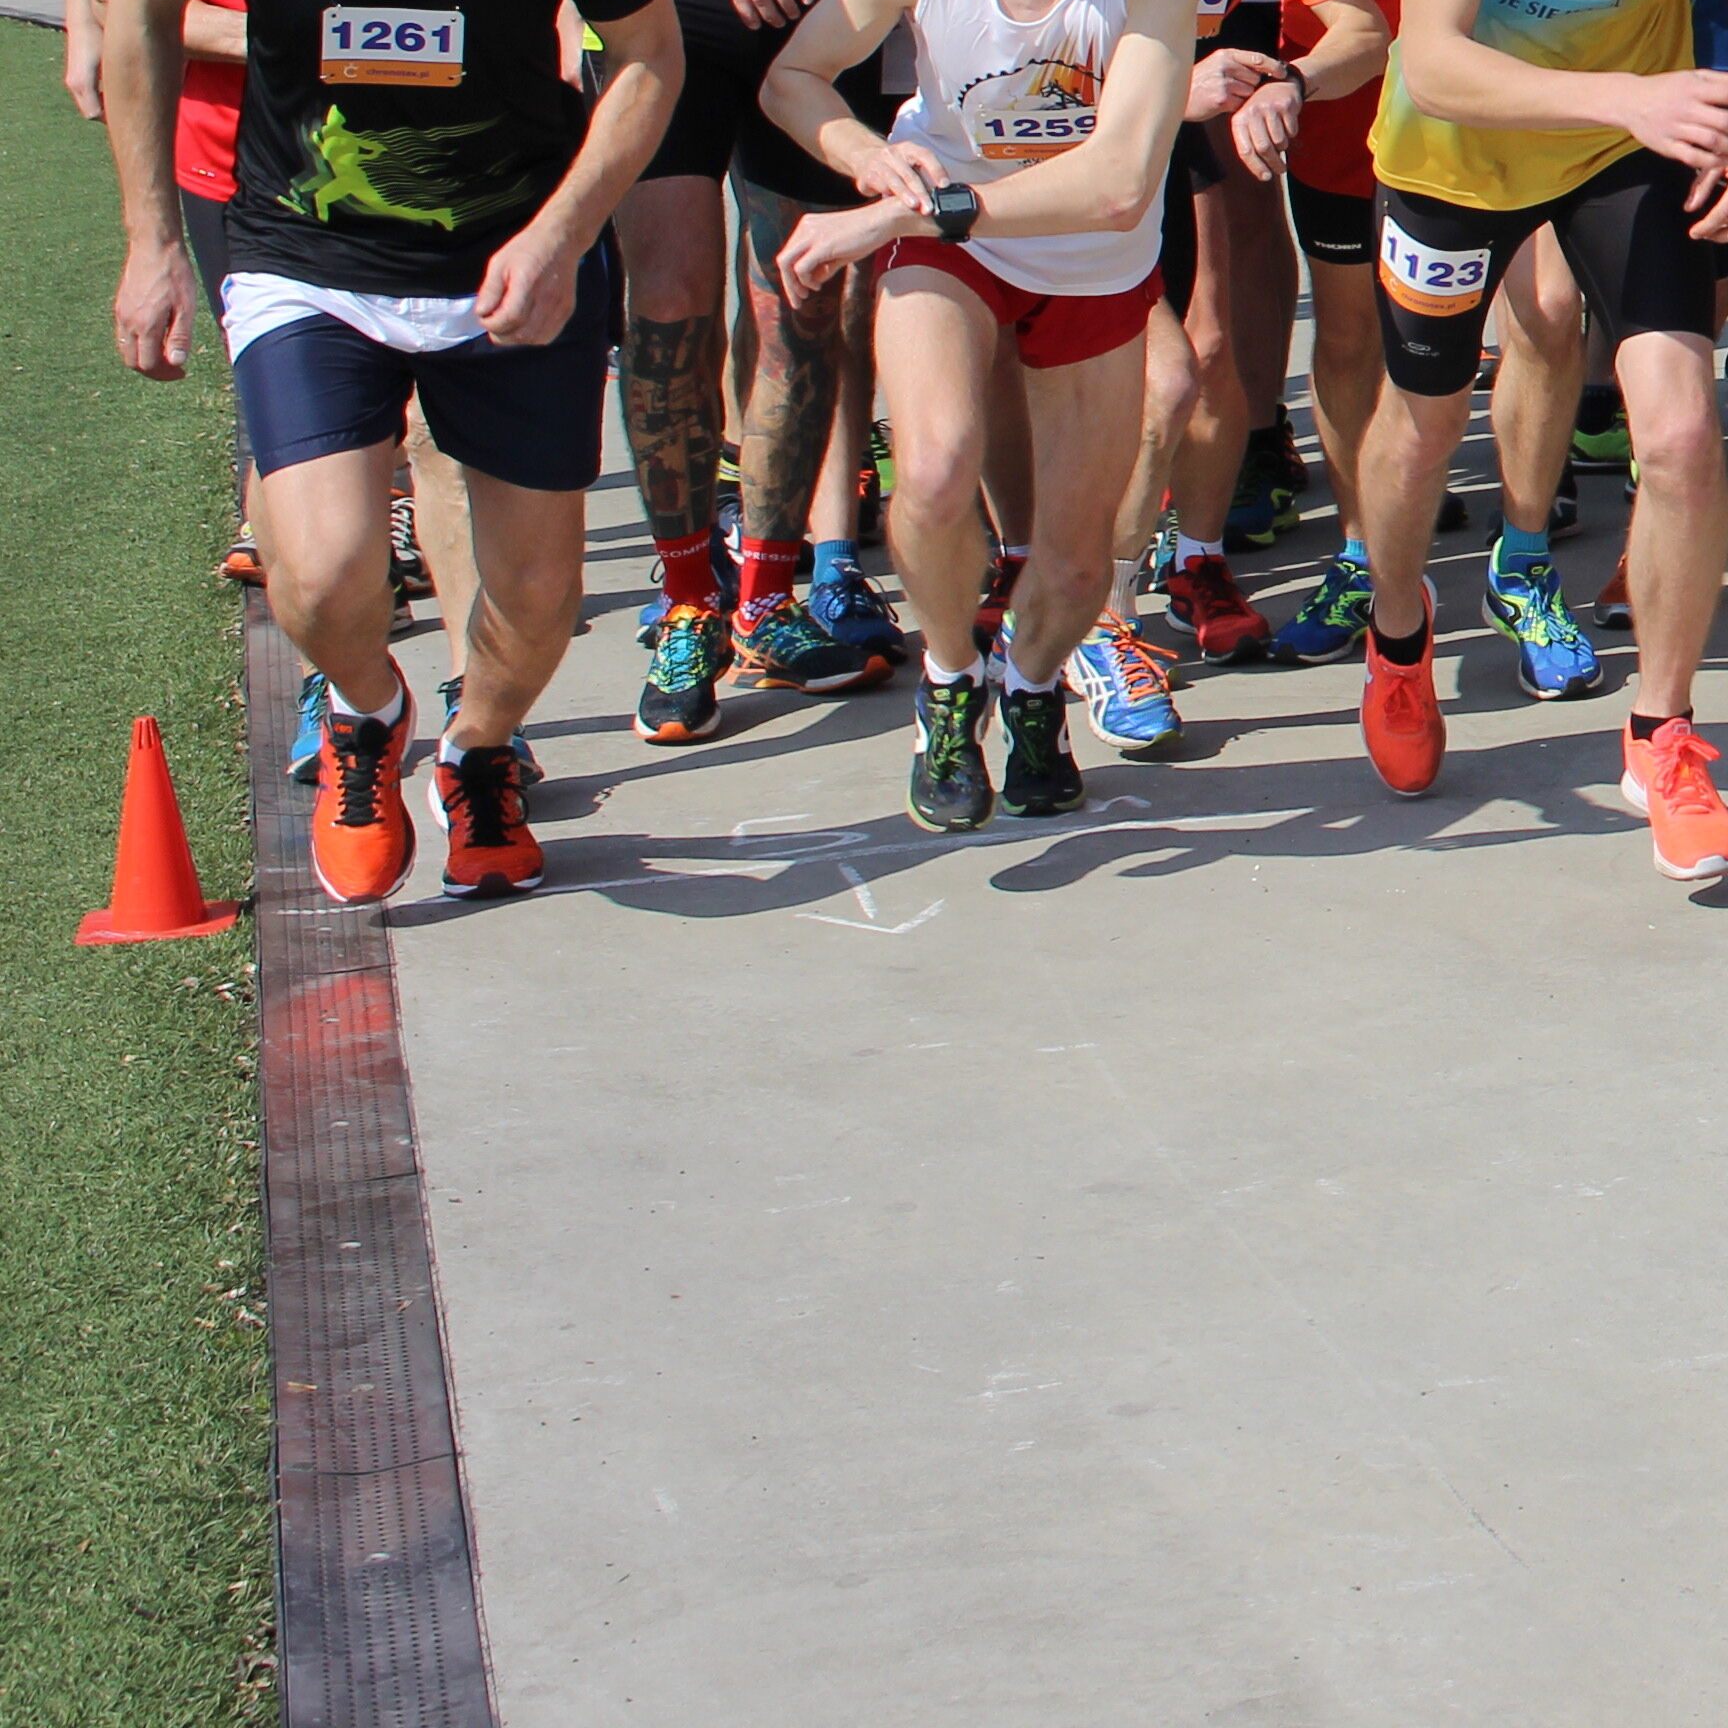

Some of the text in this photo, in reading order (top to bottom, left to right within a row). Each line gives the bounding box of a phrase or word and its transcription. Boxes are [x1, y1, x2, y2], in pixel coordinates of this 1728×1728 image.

[332, 21, 451, 53] 1261
[985, 115, 1096, 138] 1259
[1387, 235, 1483, 288] 1123
